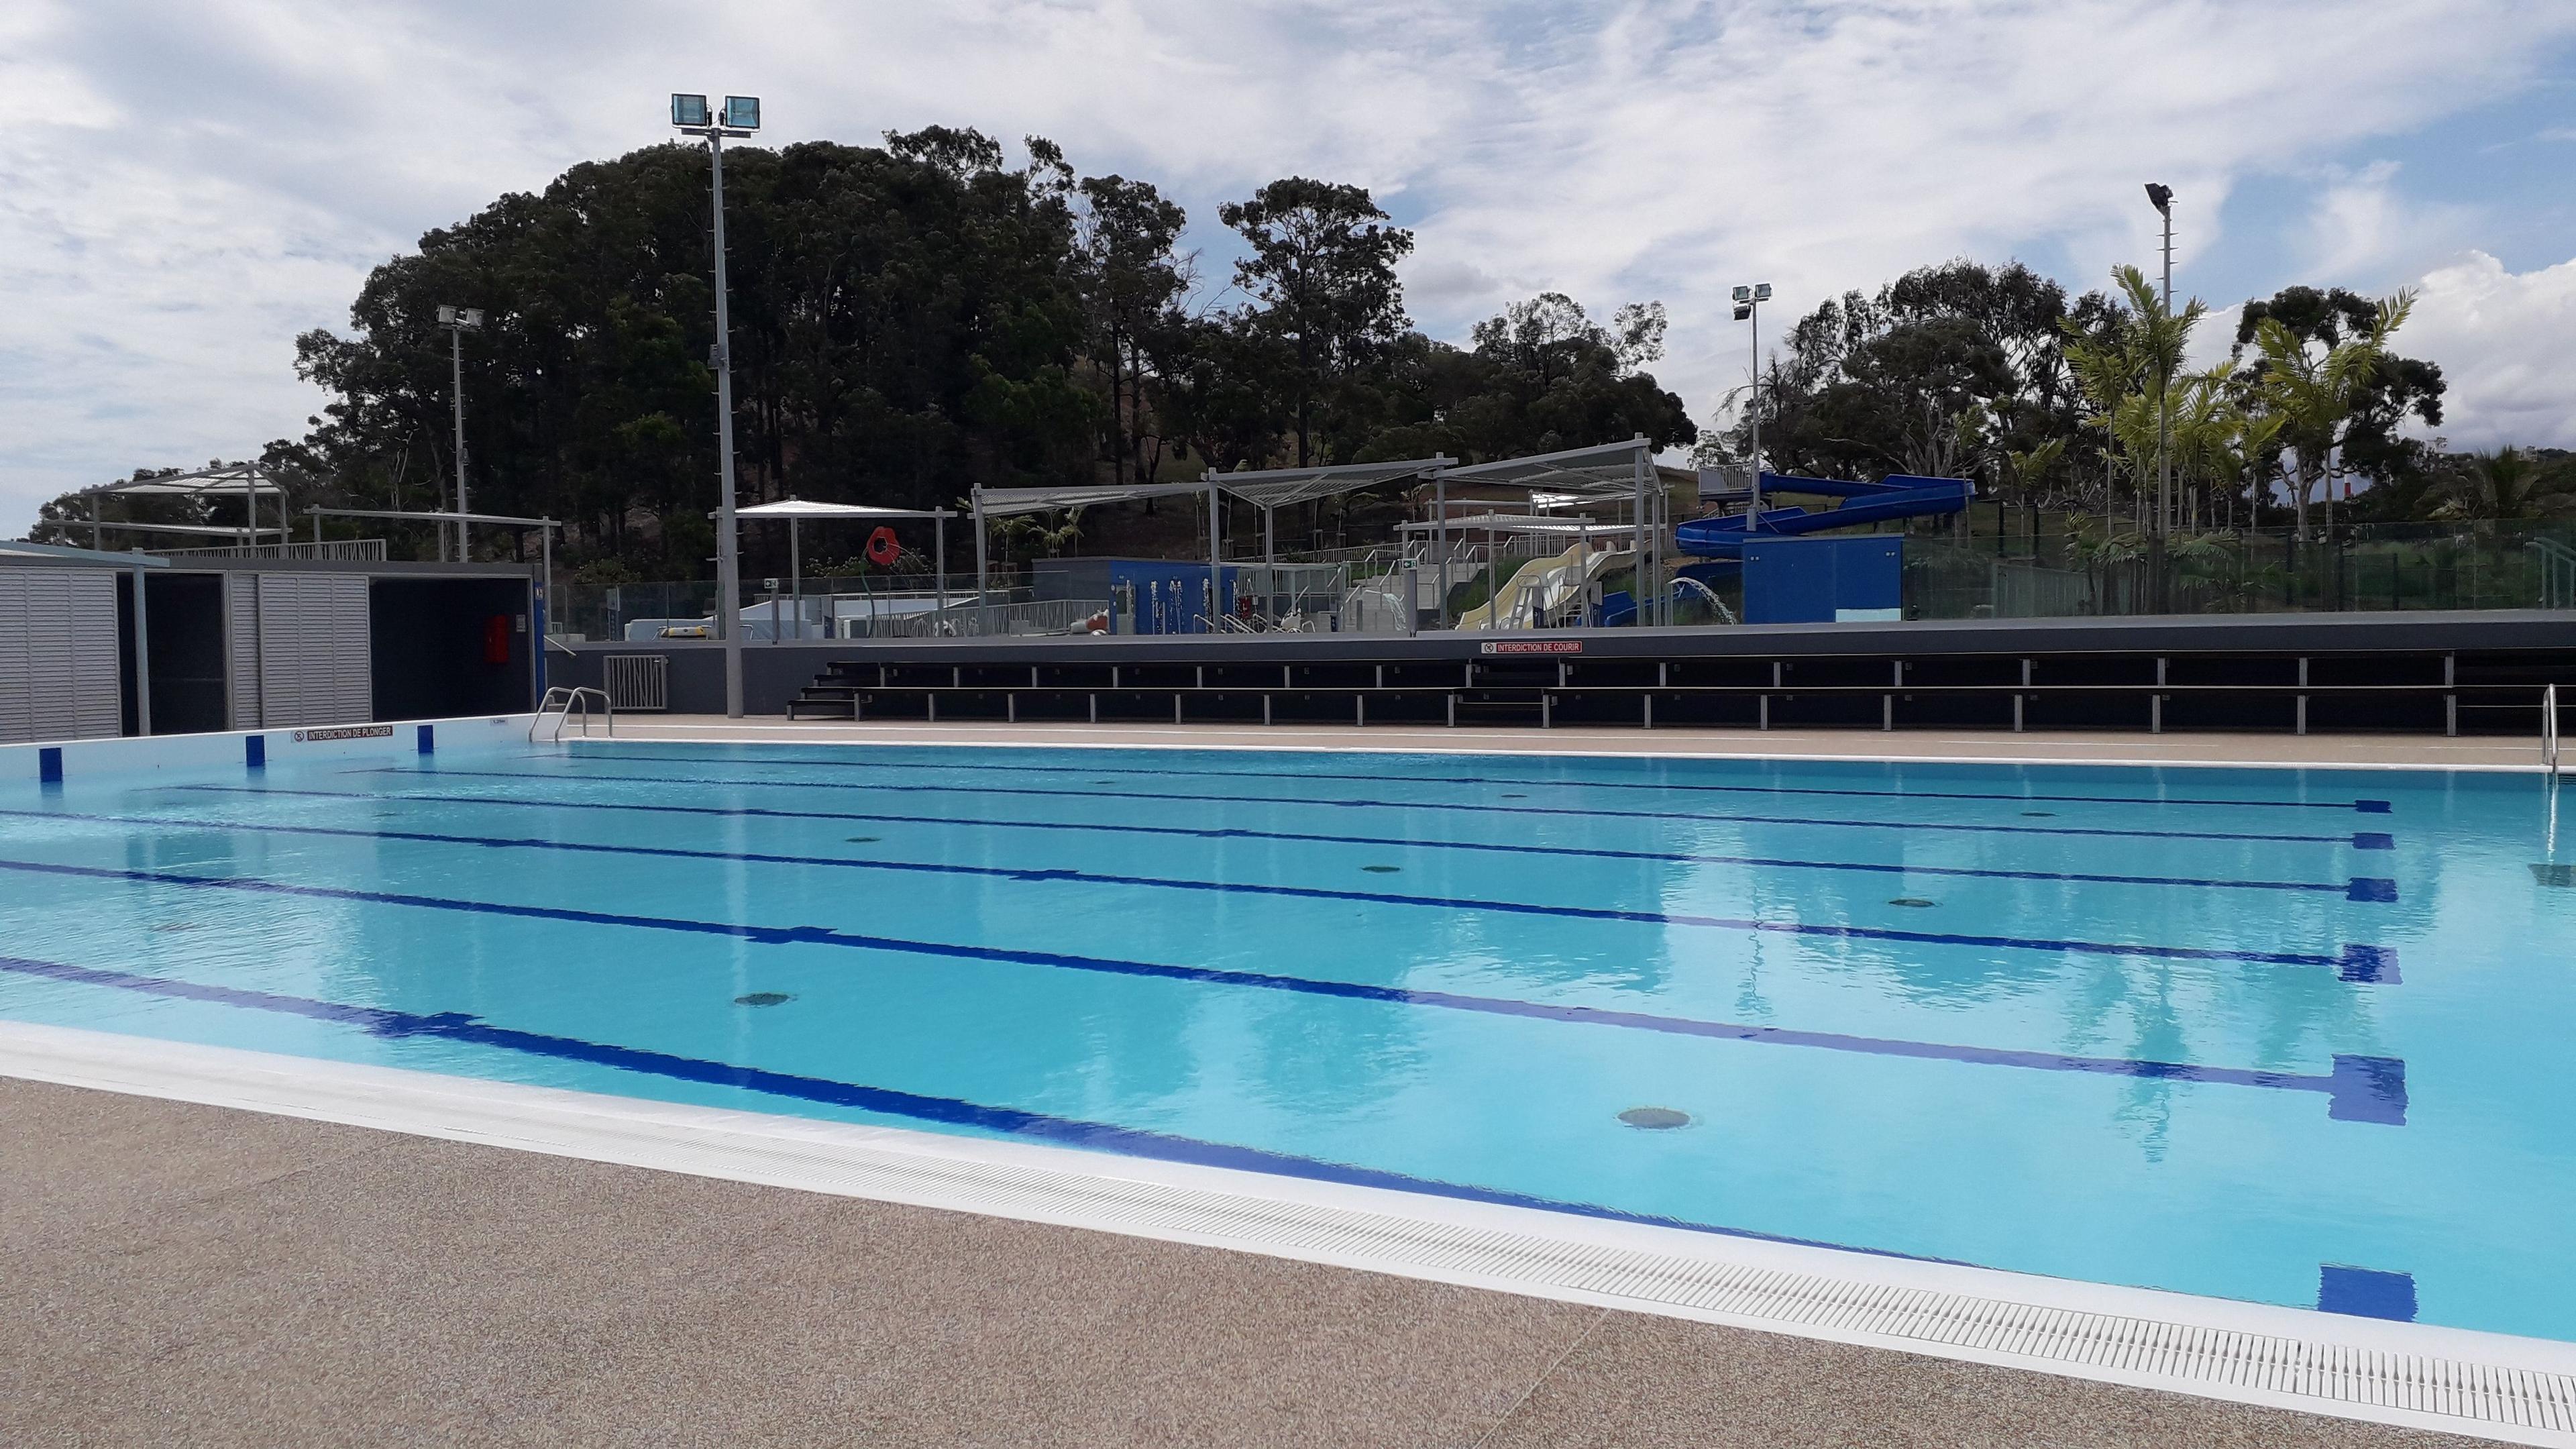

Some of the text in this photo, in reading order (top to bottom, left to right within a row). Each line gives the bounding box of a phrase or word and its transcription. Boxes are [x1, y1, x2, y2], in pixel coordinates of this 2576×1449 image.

[1498, 643, 1580, 651] INTERDICTION DE COURIR
[309, 727, 391, 740] INTERDICTION DE PLONGER
